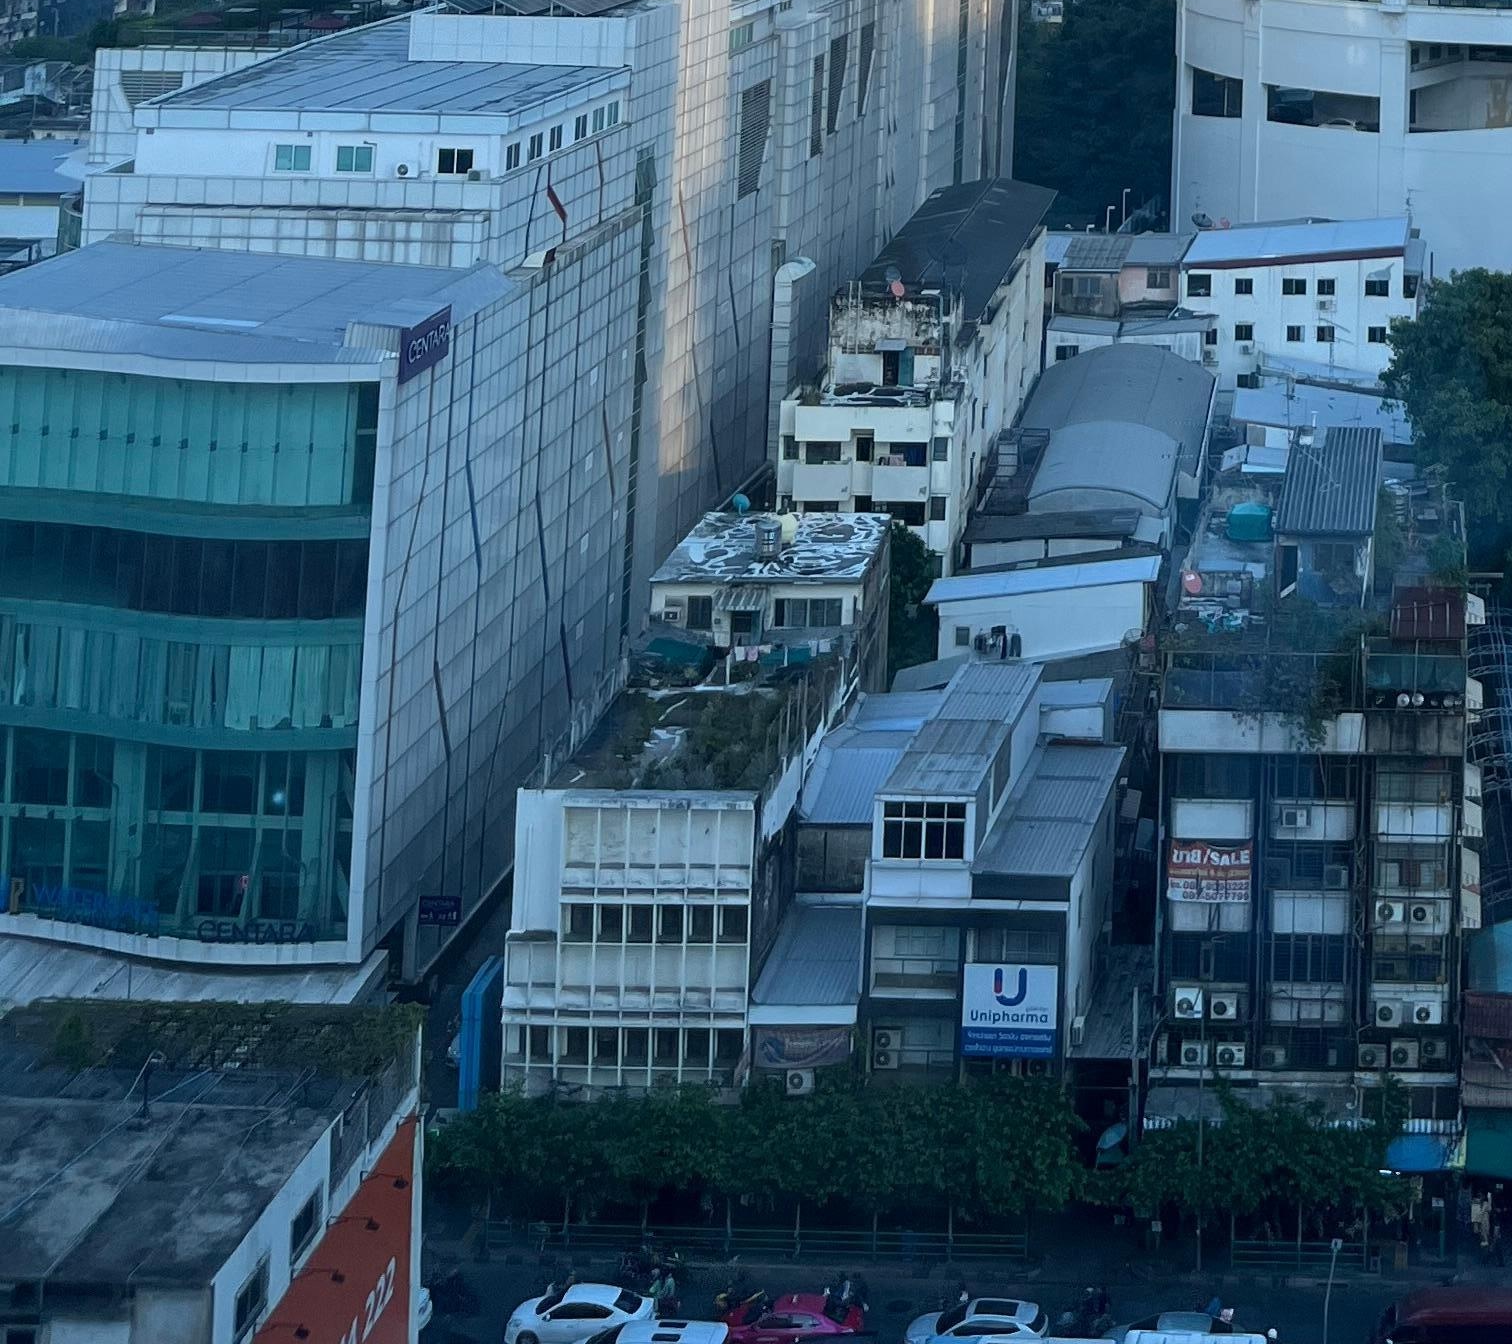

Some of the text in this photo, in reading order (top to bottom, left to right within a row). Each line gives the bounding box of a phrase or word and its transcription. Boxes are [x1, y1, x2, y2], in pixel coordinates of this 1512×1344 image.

[408, 322, 449, 363] CENTARA
[198, 920, 315, 944] CENTARA
[970, 1009, 1048, 1024] Unipharma
[361, 1255, 396, 1343] 222
